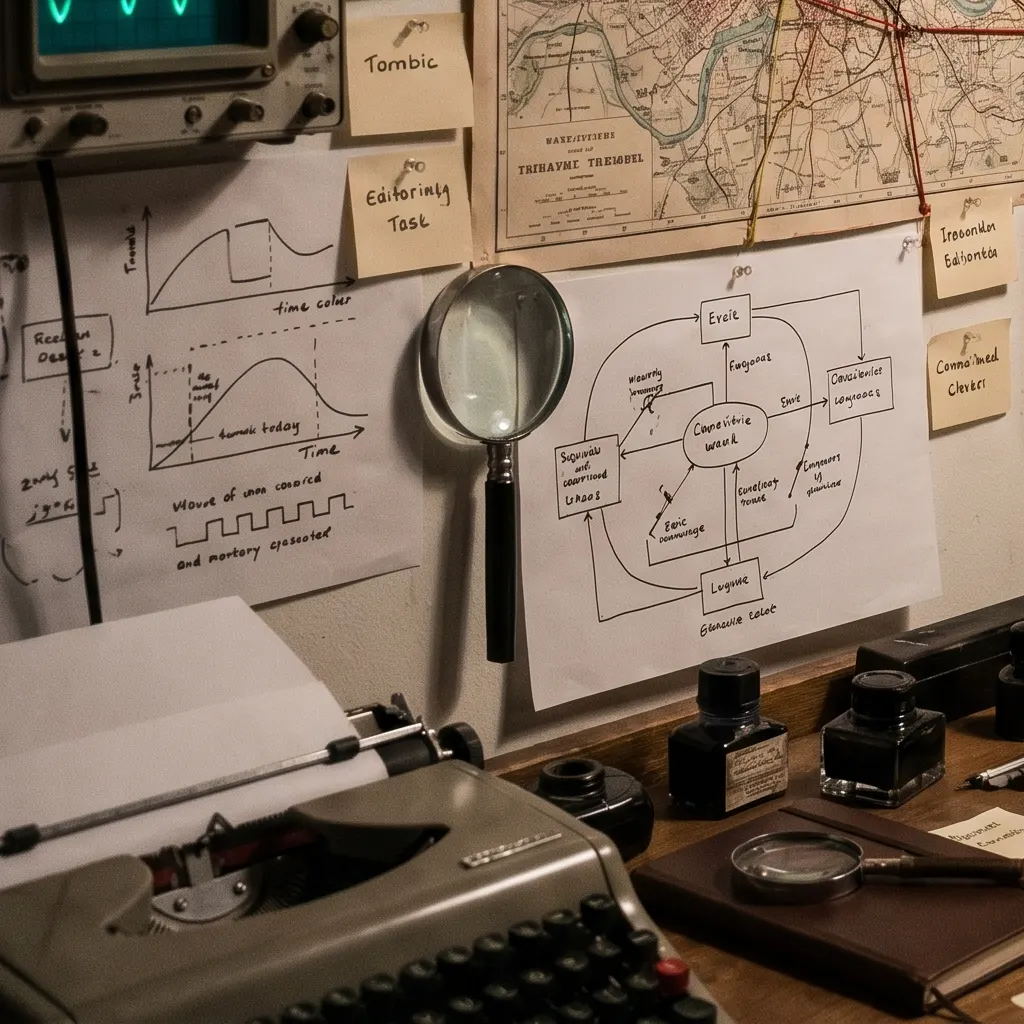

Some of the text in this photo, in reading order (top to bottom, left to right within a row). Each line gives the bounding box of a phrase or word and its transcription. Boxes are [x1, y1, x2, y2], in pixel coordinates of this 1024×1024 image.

[363, 53, 439, 74] Tombic
[297, 443, 341, 460] Time
[176, 553, 202, 571] and
